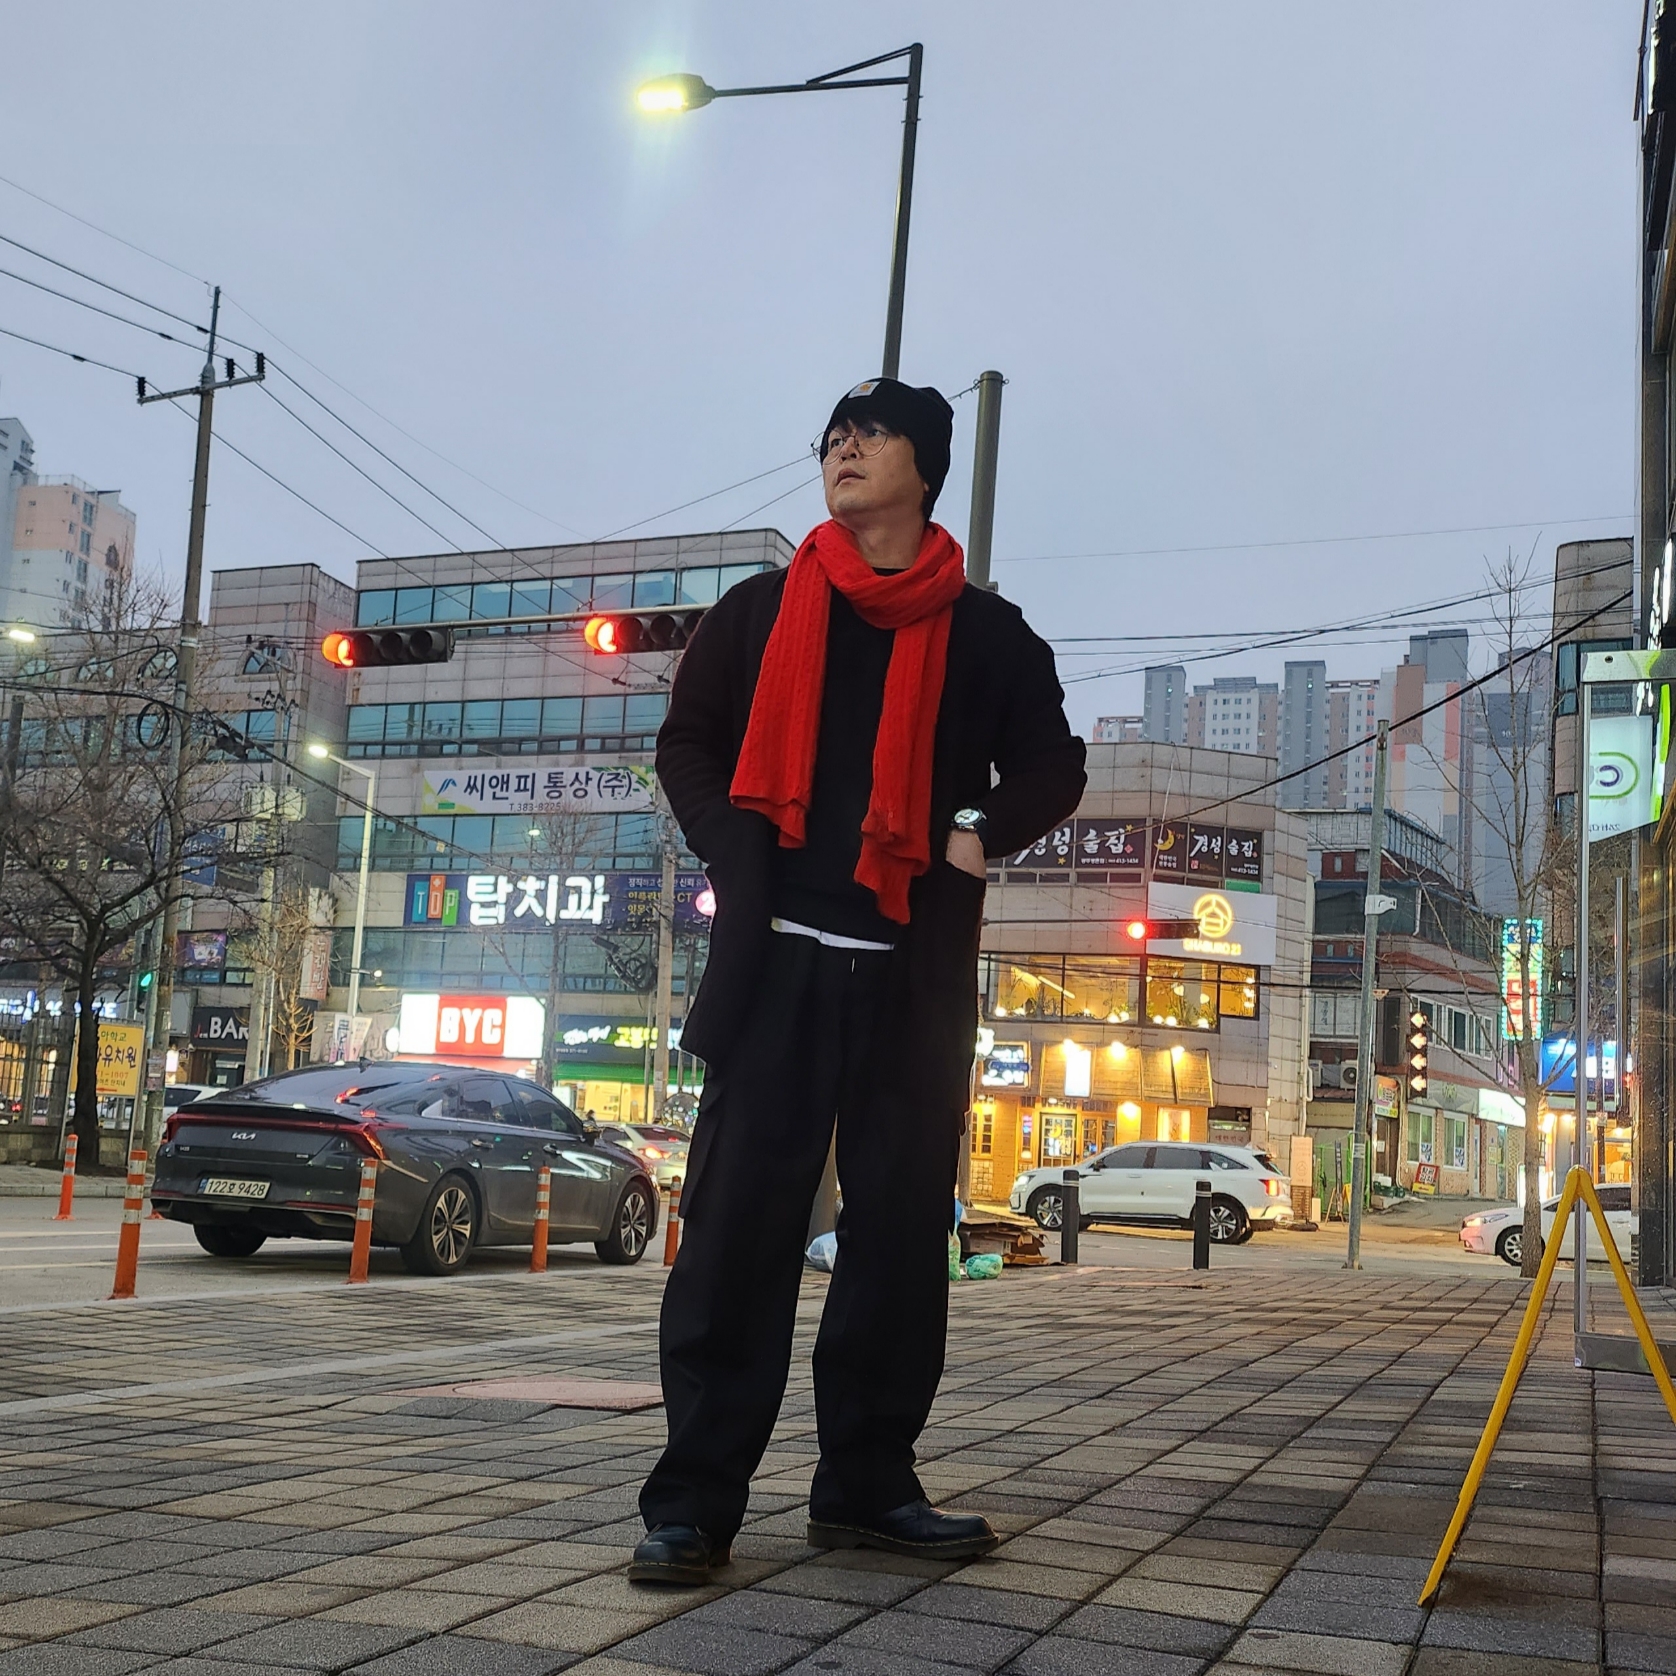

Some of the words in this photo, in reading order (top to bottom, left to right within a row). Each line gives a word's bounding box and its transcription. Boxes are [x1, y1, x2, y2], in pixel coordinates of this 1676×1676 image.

[464, 773, 535, 800] 씨앤피
[1082, 828, 1126, 855] 술집
[1189, 834, 1222, 858] 경성
[1227, 838, 1254, 858] 술집
[416, 890, 458, 916] TOP
[467, 874, 611, 927] 탑치과
[100, 1030, 127, 1042] 아학교
[439, 1006, 503, 1045] BYC
[97, 1070, 129, 1080] 1-1007
[208, 1180, 234, 1193] 122호
[237, 1181, 266, 1197] 9428
